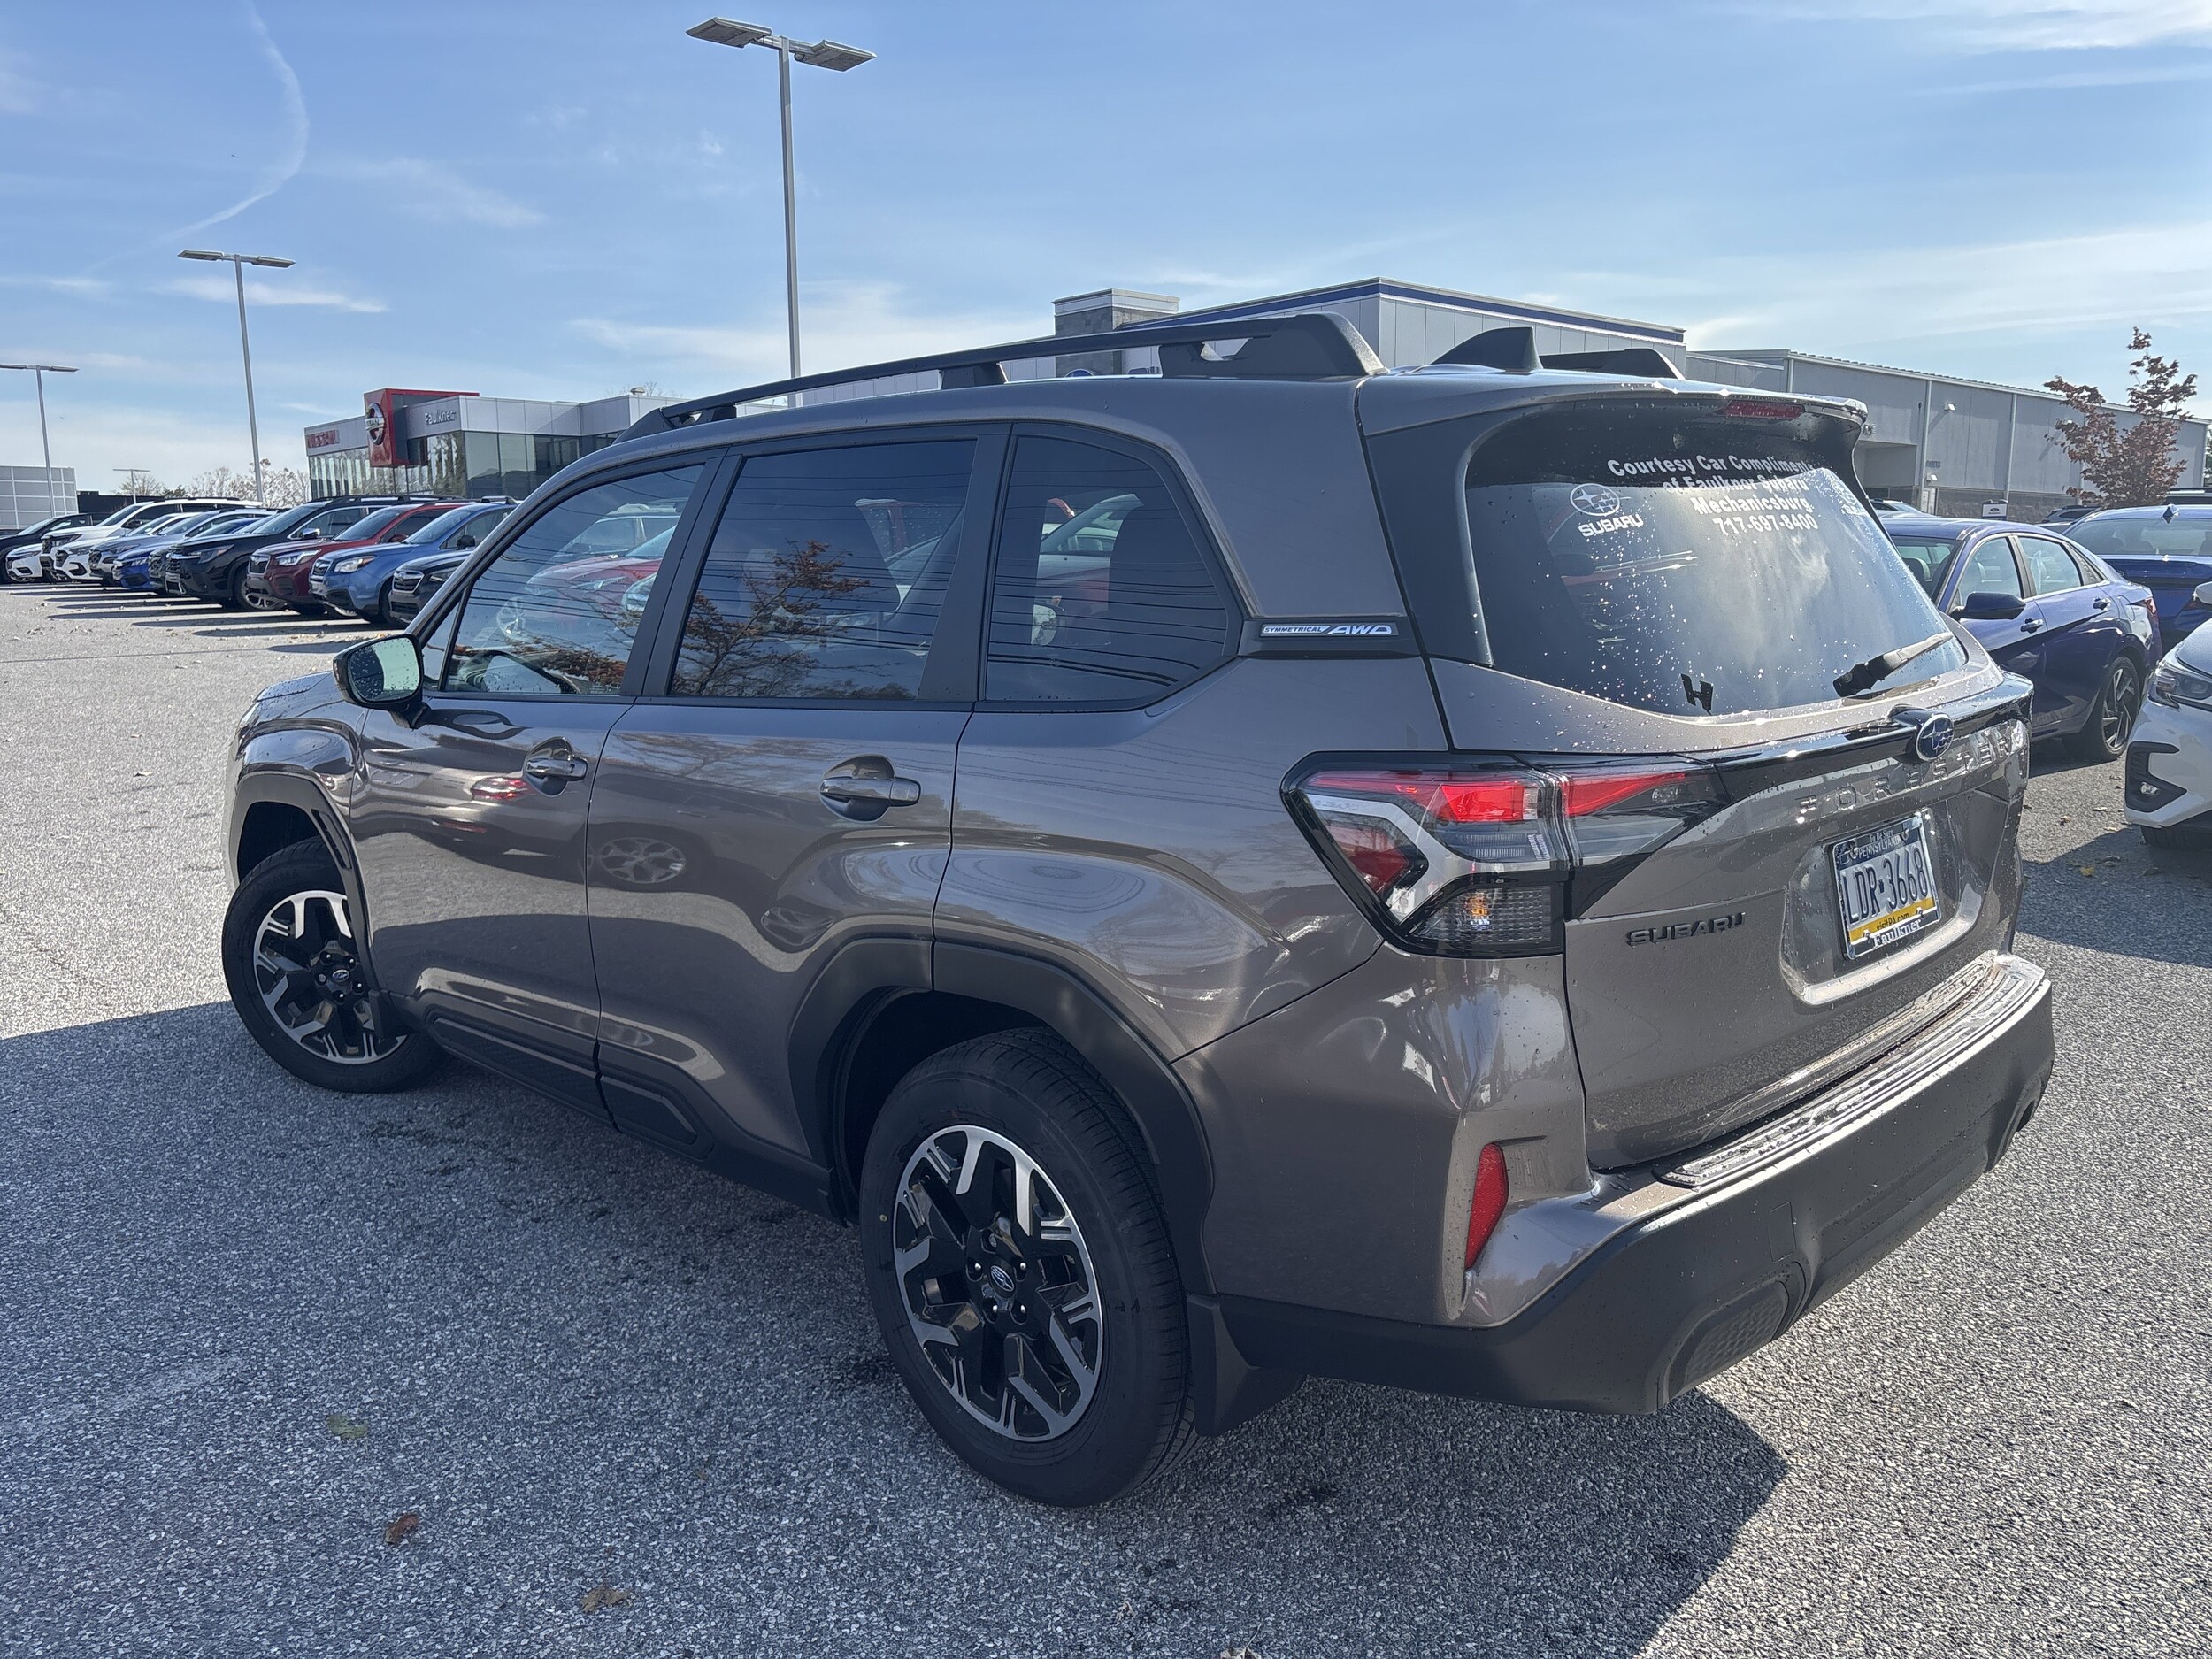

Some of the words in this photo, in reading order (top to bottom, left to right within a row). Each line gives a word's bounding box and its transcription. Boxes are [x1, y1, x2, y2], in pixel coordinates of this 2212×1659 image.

[1607, 457, 1696, 476] Courtesy
[1696, 455, 1728, 471] Car
[1728, 455, 1816, 473] Compliments
[1663, 476, 1683, 495] of
[1682, 475, 1759, 493] Faulkner
[1757, 474, 1809, 492] Subaru
[1578, 513, 1644, 537] SUBARU
[1712, 513, 1819, 536] 717-697-8400
[1326, 625, 1393, 635] AWD
[1795, 733, 2011, 811] FORESTER
[1625, 912, 1746, 948] SUBARU
[1872, 918, 1922, 947] Faulkner
